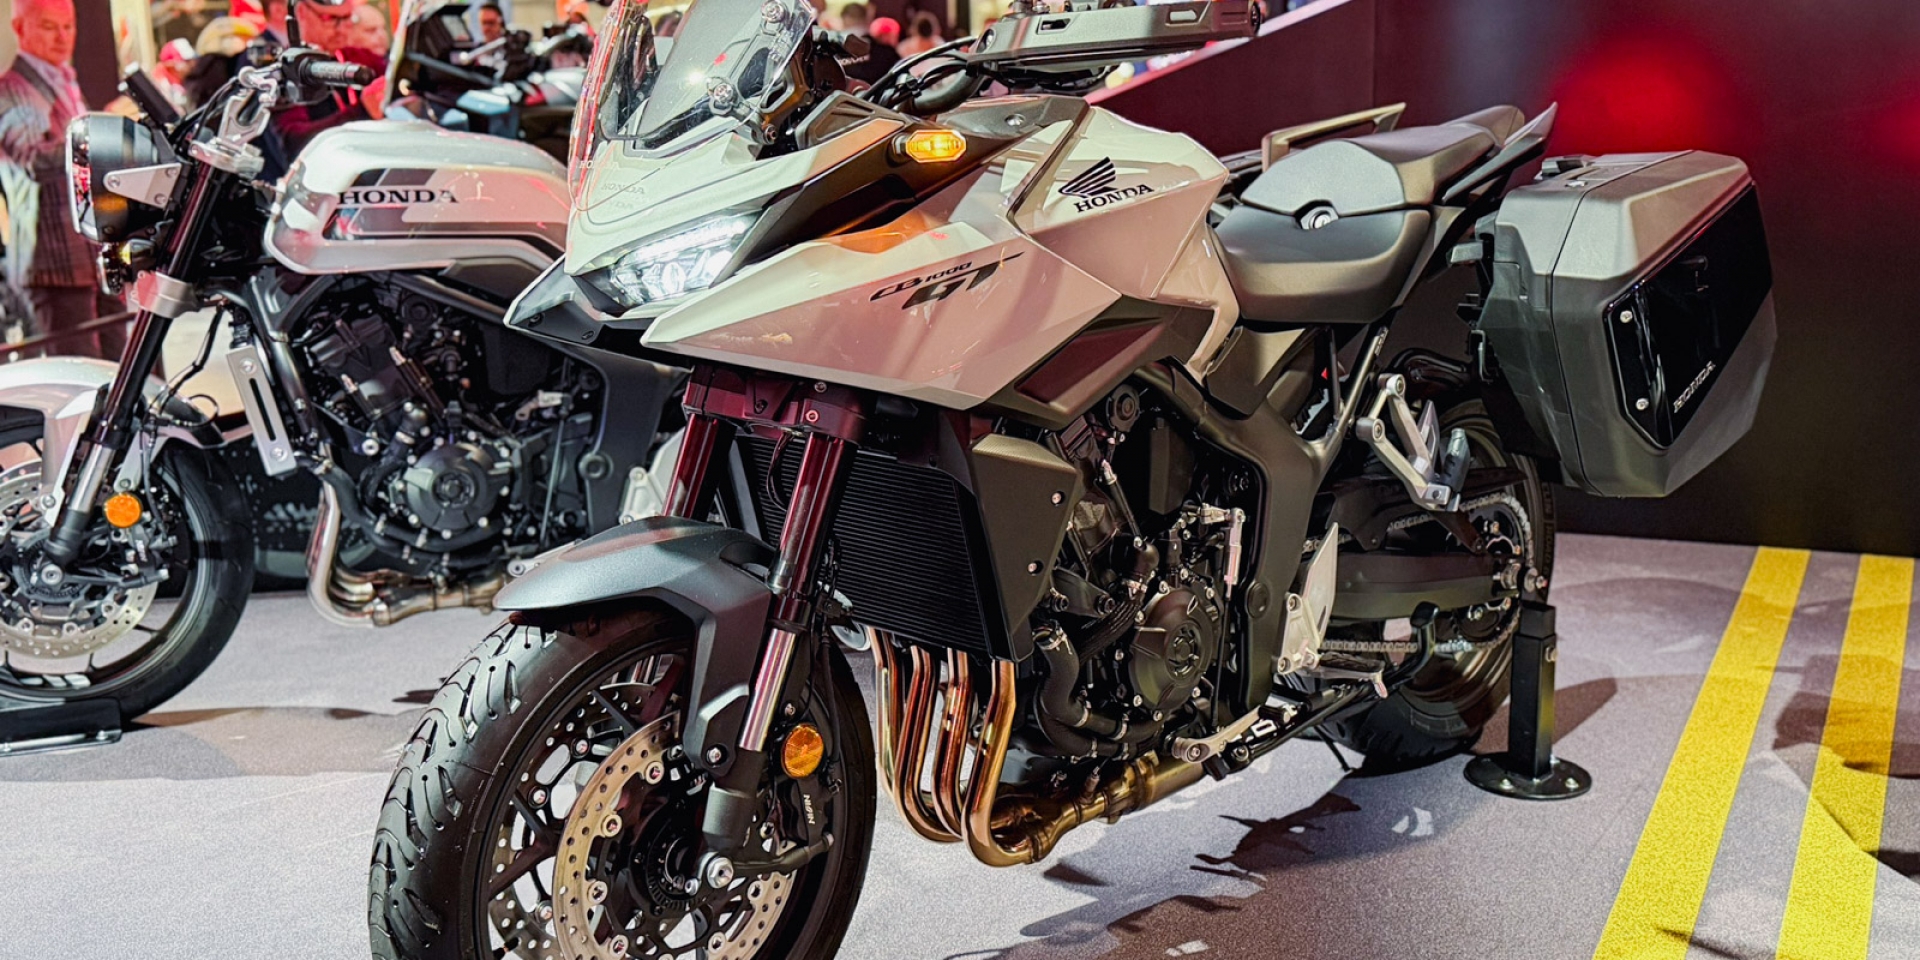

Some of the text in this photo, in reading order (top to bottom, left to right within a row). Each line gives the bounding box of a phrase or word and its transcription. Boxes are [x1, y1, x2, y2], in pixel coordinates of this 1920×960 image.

[337, 189, 459, 205] HONDA
[1073, 184, 1155, 213] HONDA
[1673, 360, 1716, 414] HONDA
